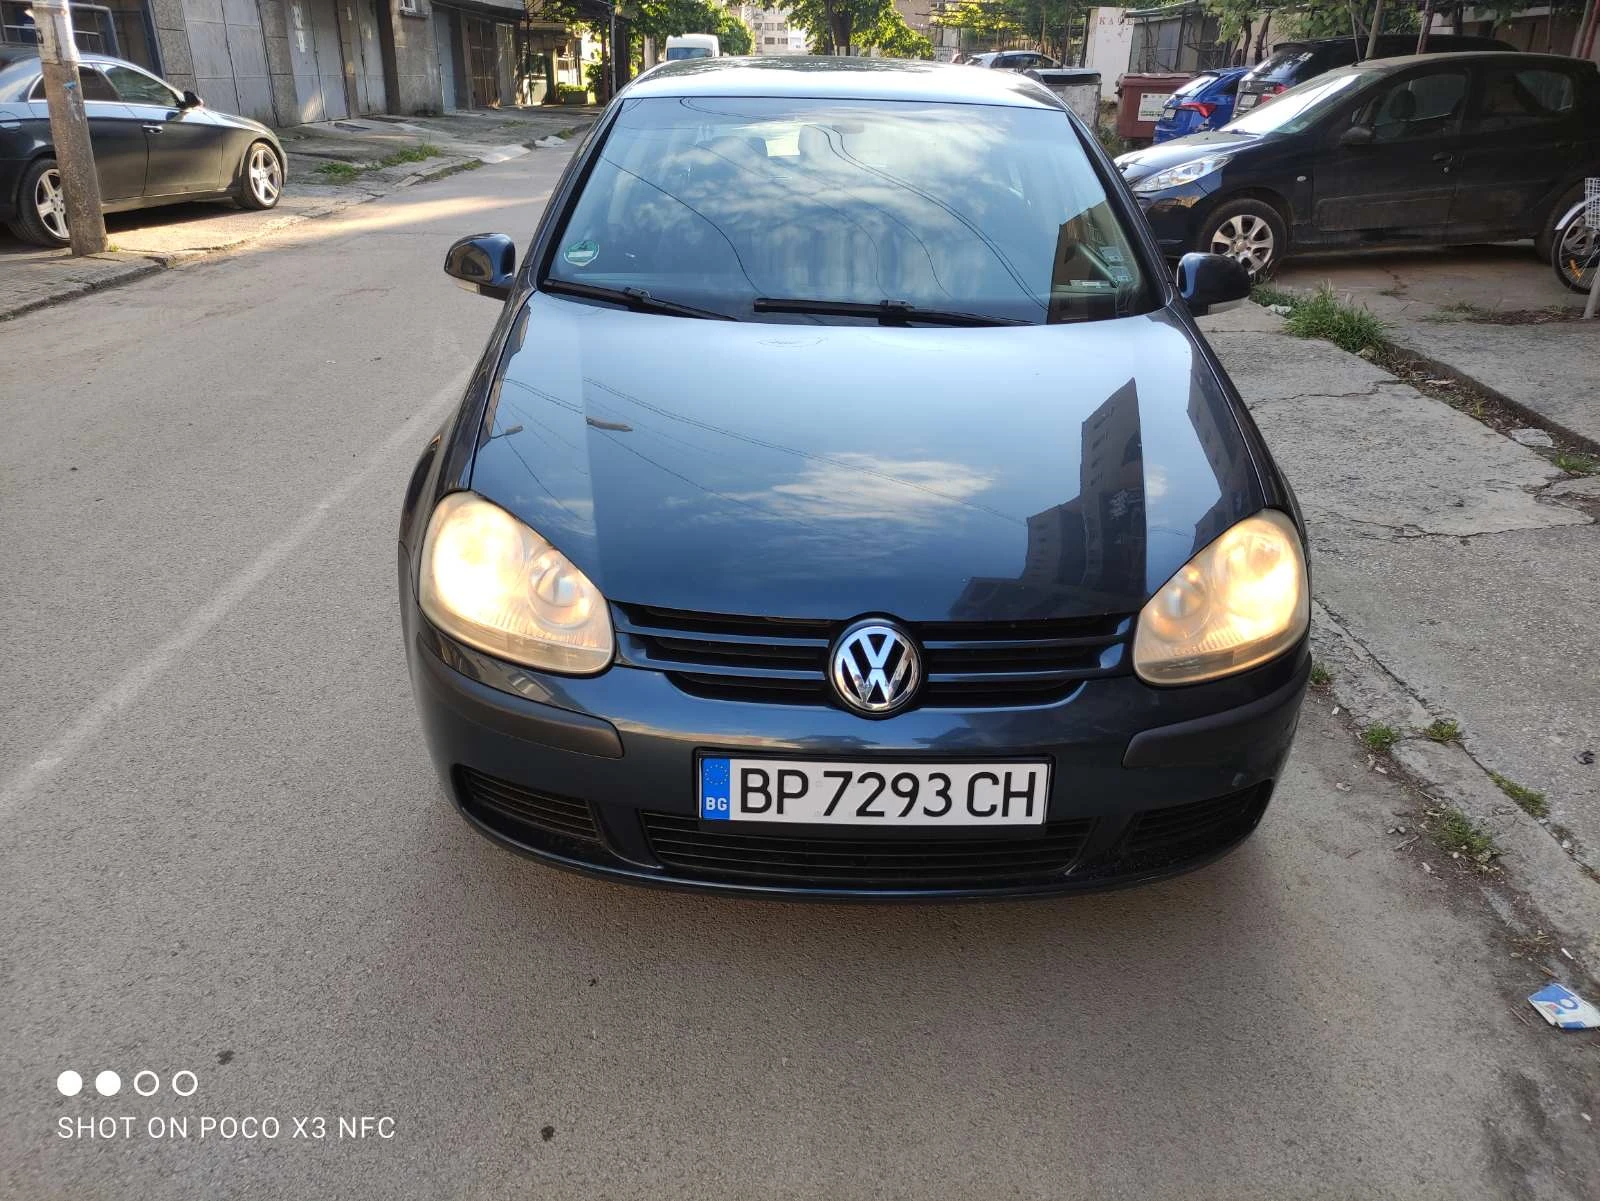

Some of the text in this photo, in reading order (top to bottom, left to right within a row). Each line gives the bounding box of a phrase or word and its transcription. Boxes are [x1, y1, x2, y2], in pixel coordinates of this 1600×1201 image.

[705, 796, 728, 811] BG
[740, 767, 1037, 818] BP 7293 CH
